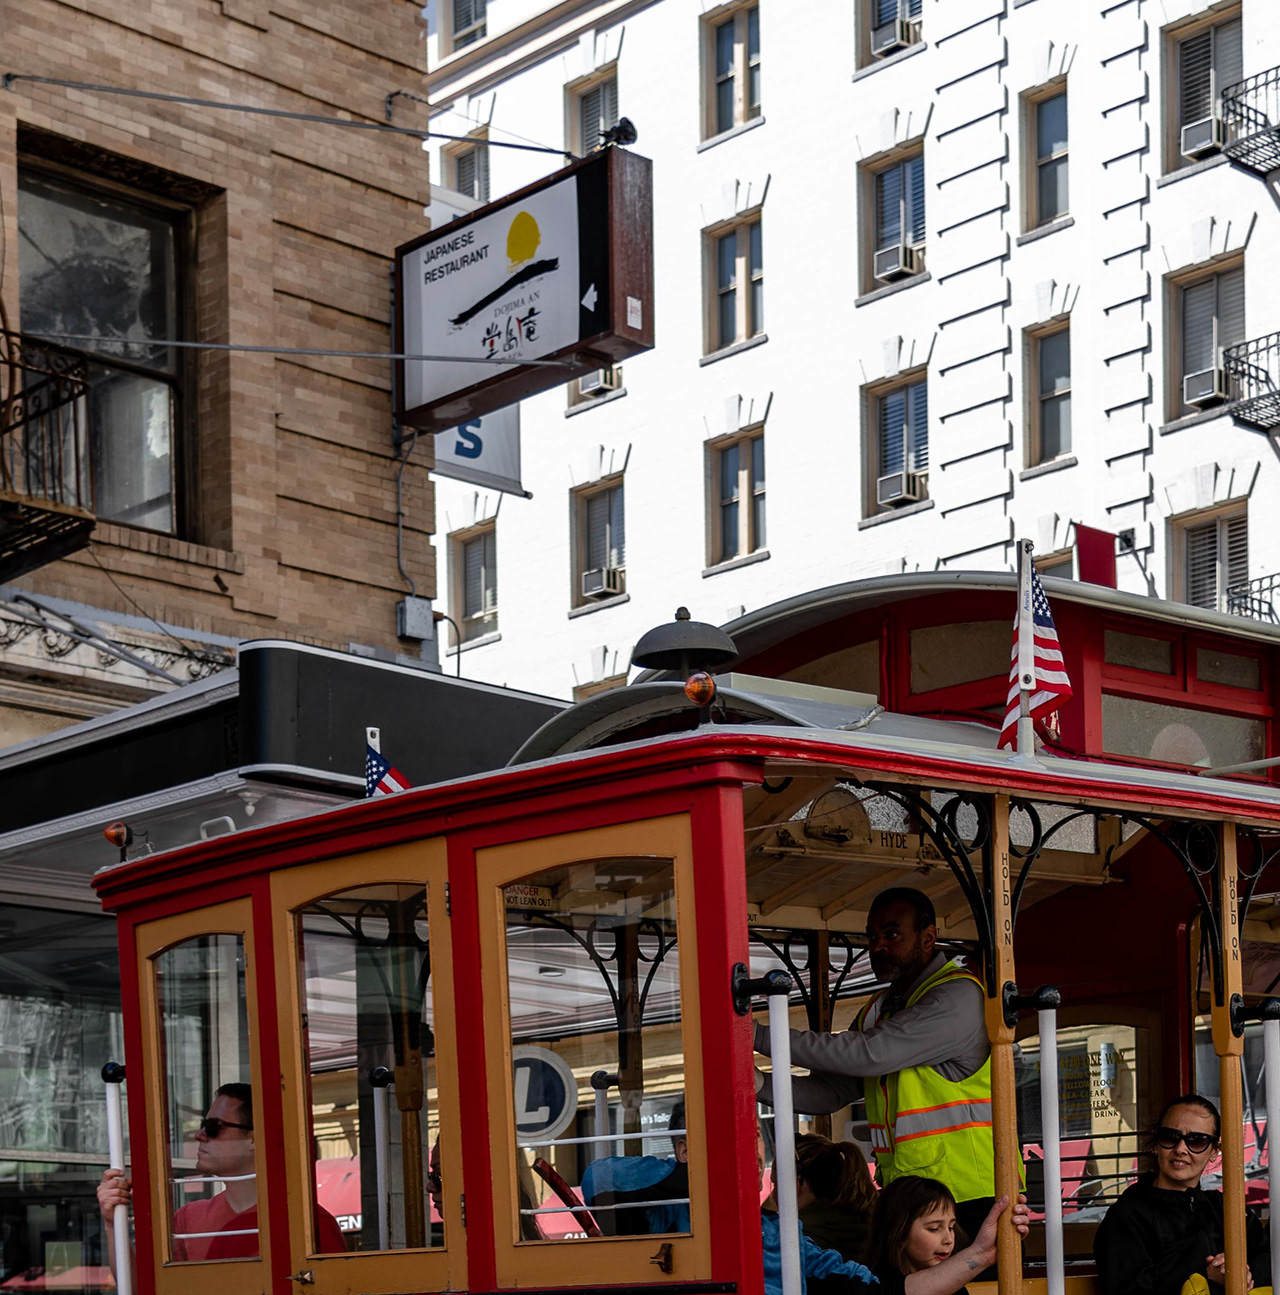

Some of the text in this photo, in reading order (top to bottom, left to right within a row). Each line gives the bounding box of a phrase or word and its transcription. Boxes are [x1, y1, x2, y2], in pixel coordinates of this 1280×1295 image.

[424, 231, 474, 265] JAPANESE
[424, 245, 489, 285] RESTAURANT
[881, 832, 907, 849] HYDE
[520, 897, 537, 906] LEAN
[538, 898, 552, 907] OUT
[1001, 853, 1012, 946] HOLD ON
[1229, 876, 1239, 961] HOLD ON
[1083, 1053, 1101, 1067] ONE
[1105, 1050, 1126, 1065] WAY
[1093, 1078, 1117, 1087] FLOOR
[515, 1066, 550, 1125] L
[1080, 1089, 1105, 1098] CLEAR
[1094, 1109, 1119, 1119] DRINK
